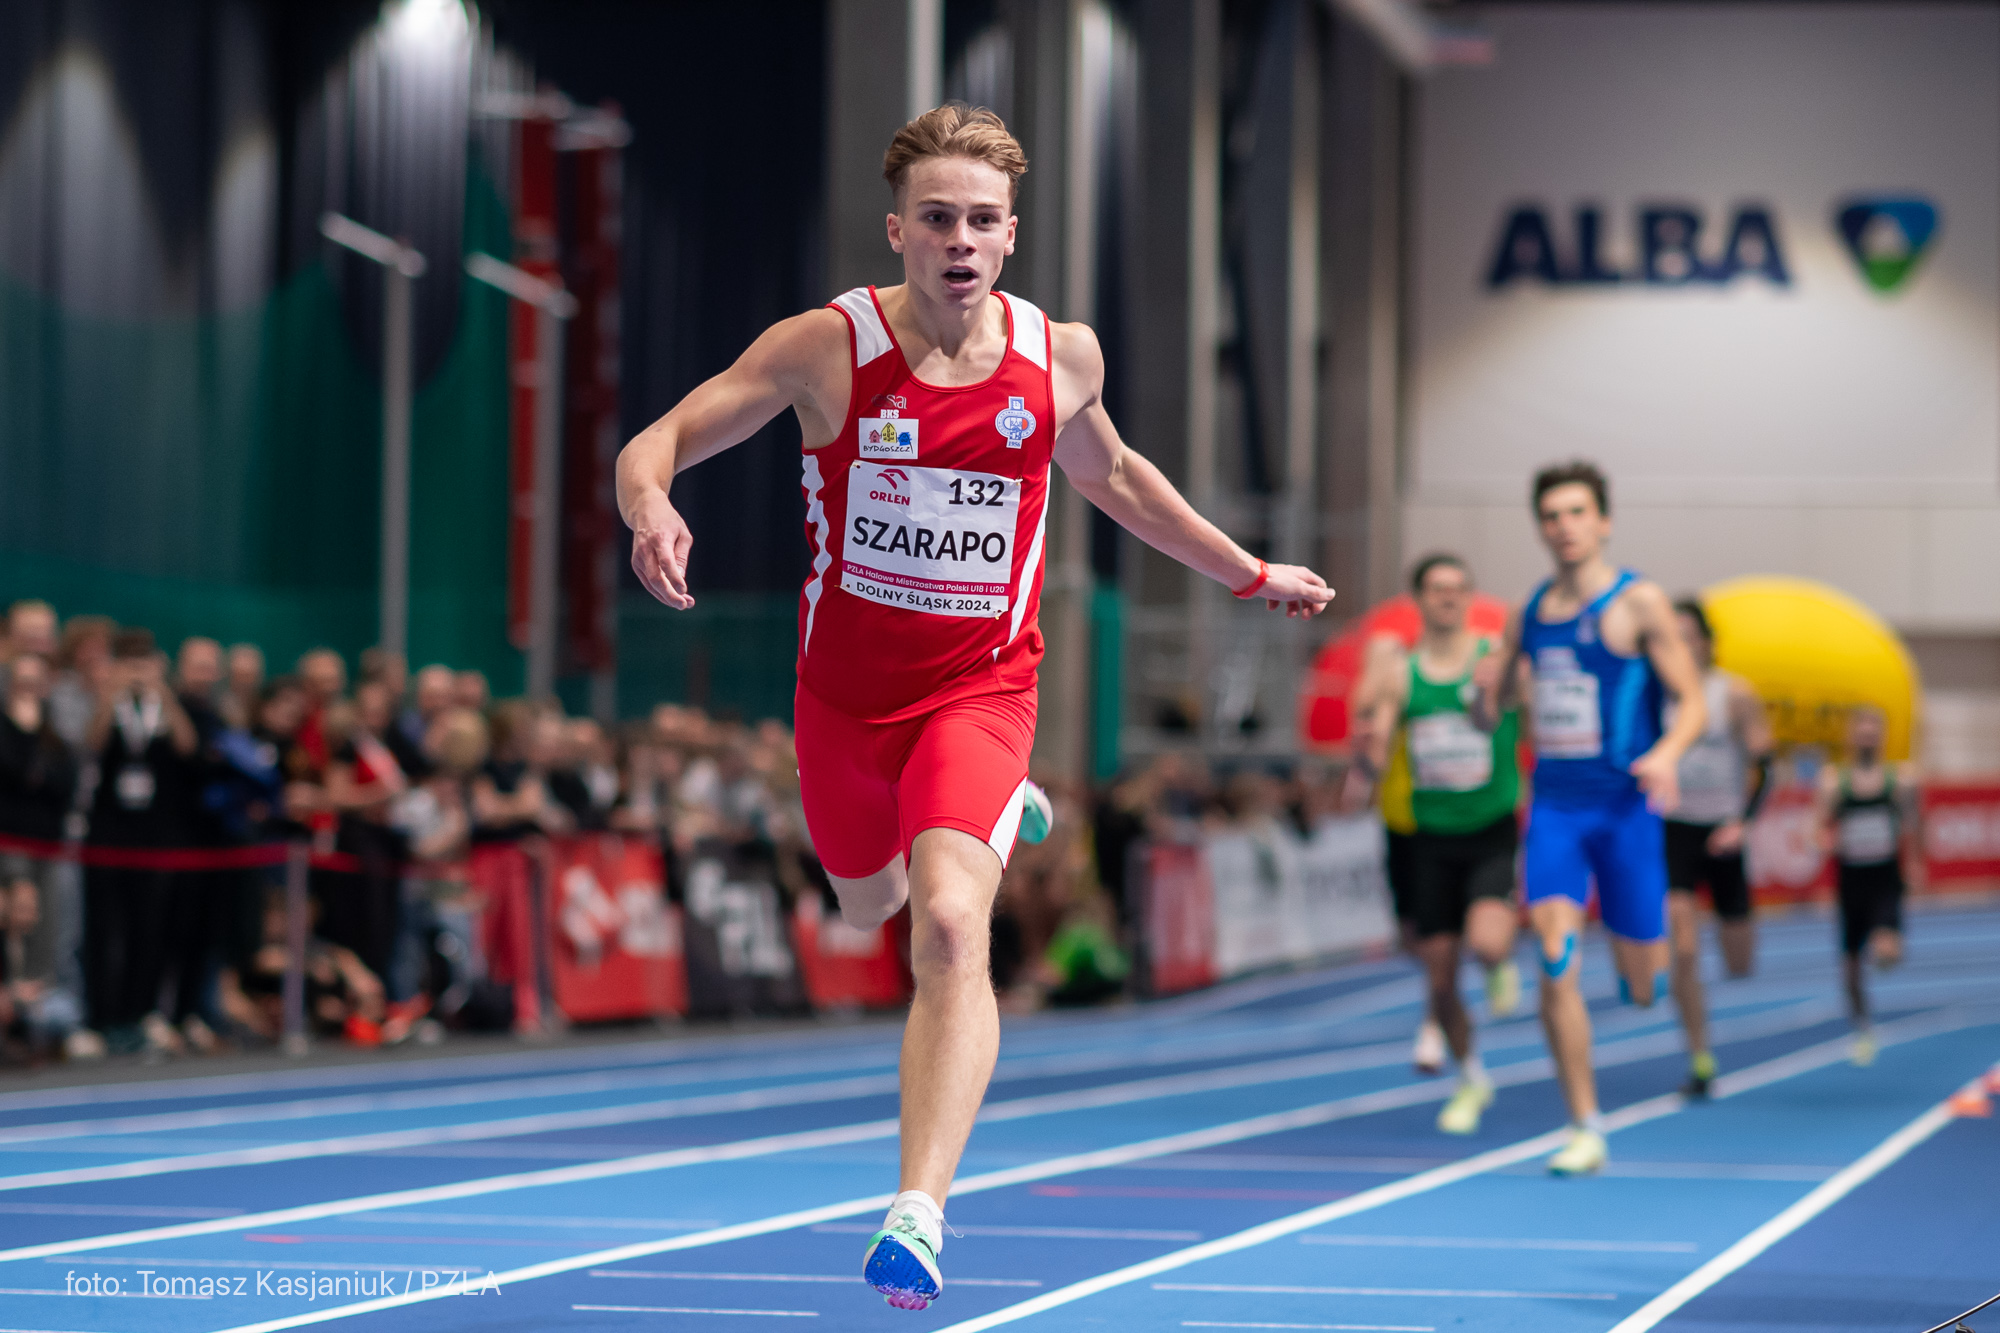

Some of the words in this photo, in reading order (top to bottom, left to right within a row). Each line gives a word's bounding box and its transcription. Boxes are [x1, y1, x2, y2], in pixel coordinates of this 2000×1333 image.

[1486, 202, 1794, 286] ALBA
[880, 409, 899, 419] BKS
[863, 445, 911, 453] BYDGOSZCZ
[869, 490, 911, 506] ORLEN
[948, 478, 1005, 507] 132
[852, 516, 1006, 563] SZARAPO
[846, 564, 864, 575] PZLA
[865, 569, 895, 583] Halowe
[895, 577, 944, 591] Mistrzostwa
[945, 583, 970, 592] Polski
[970, 585, 984, 593] U18
[989, 585, 1005, 593] U20
[856, 581, 904, 602] DOLNY
[906, 591, 953, 611] ŚLĄSK
[955, 599, 991, 612] 2024
